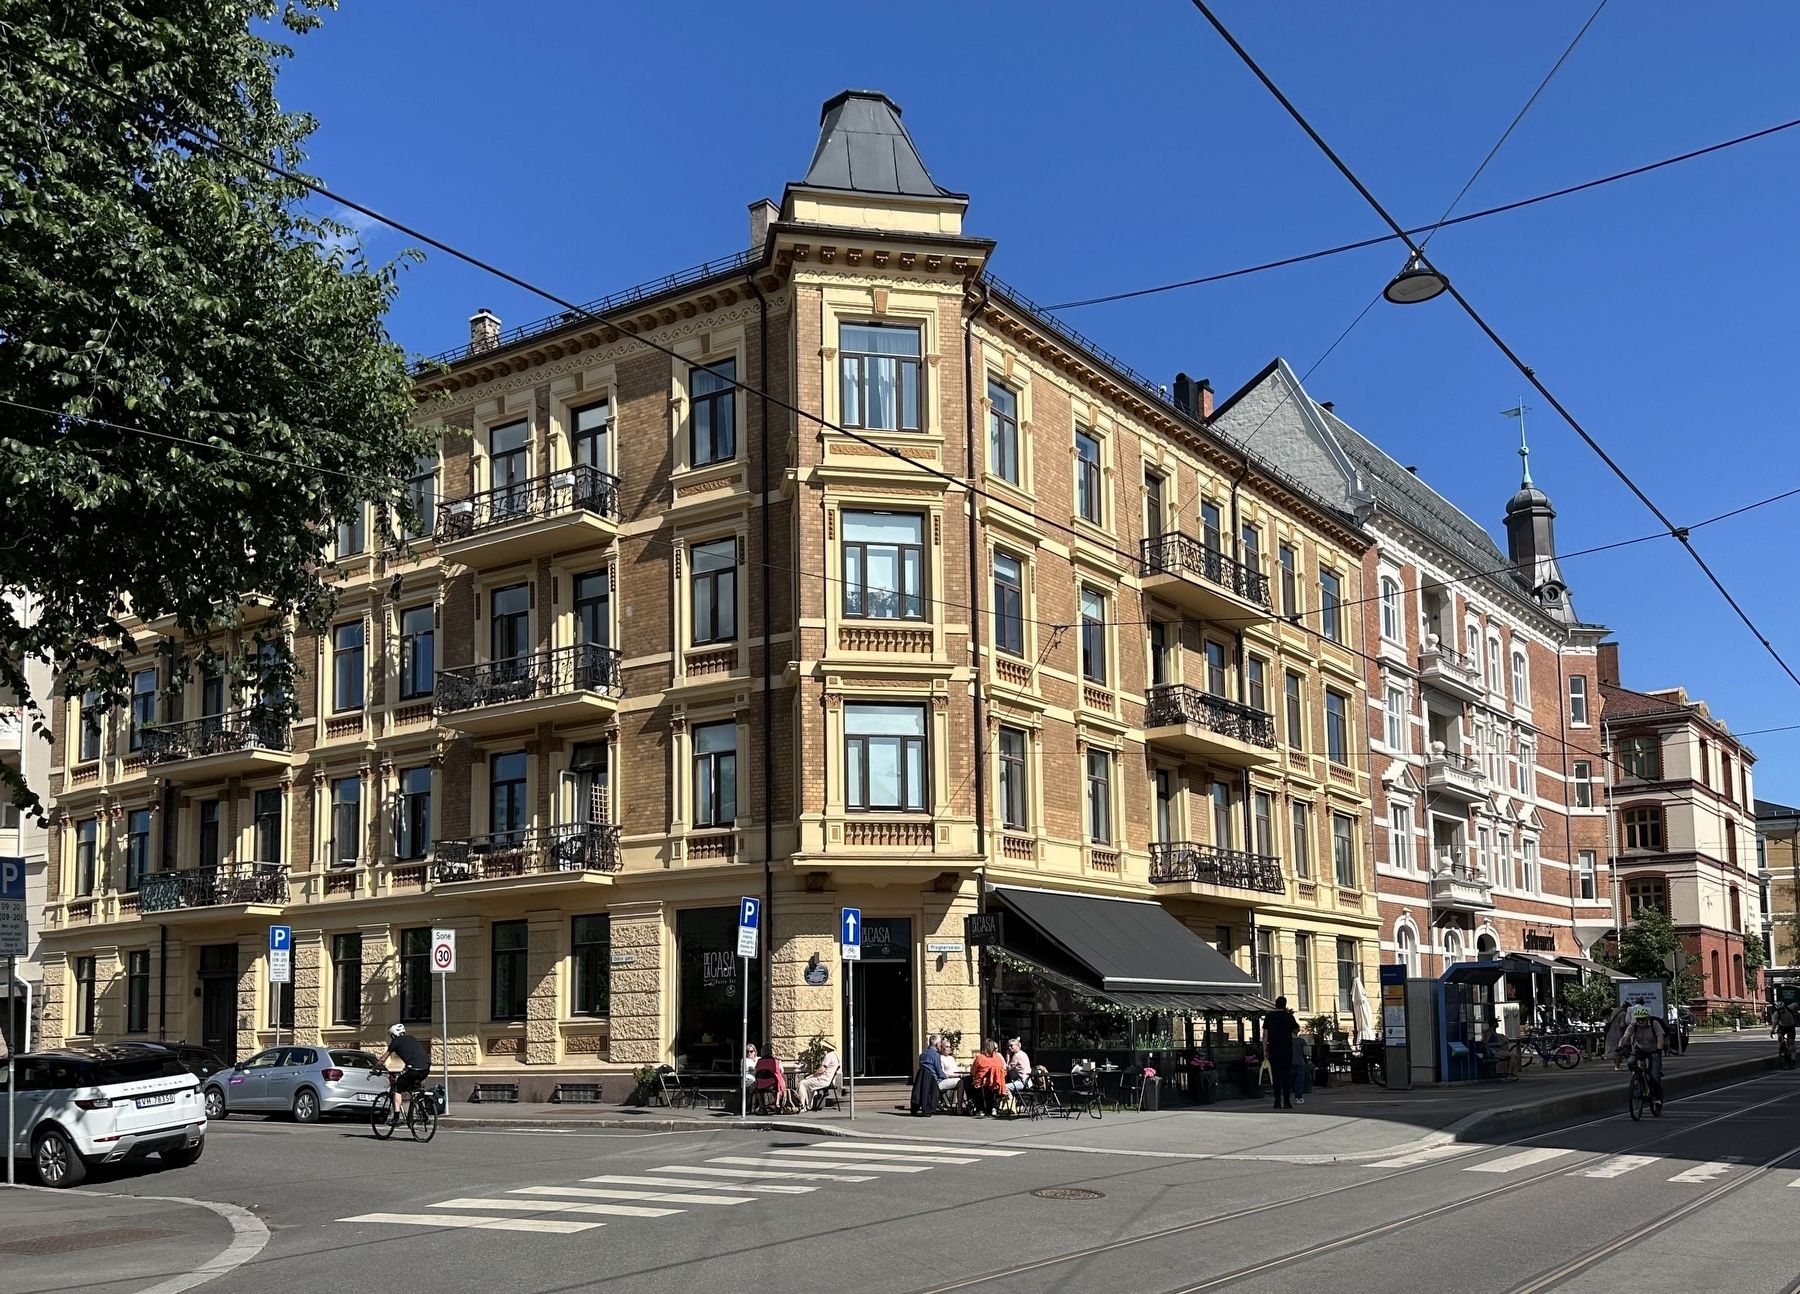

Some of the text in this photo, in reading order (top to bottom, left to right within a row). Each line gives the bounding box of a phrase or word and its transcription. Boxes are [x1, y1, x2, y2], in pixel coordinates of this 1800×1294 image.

[2, 863, 18, 893] P
[744, 902, 754, 923] P
[977, 916, 996, 932] CASA
[275, 929, 285, 947] P
[436, 931, 452, 941] Sone
[868, 927, 890, 943] CASA
[438, 950, 450, 962] 30
[711, 951, 736, 977] CASA
